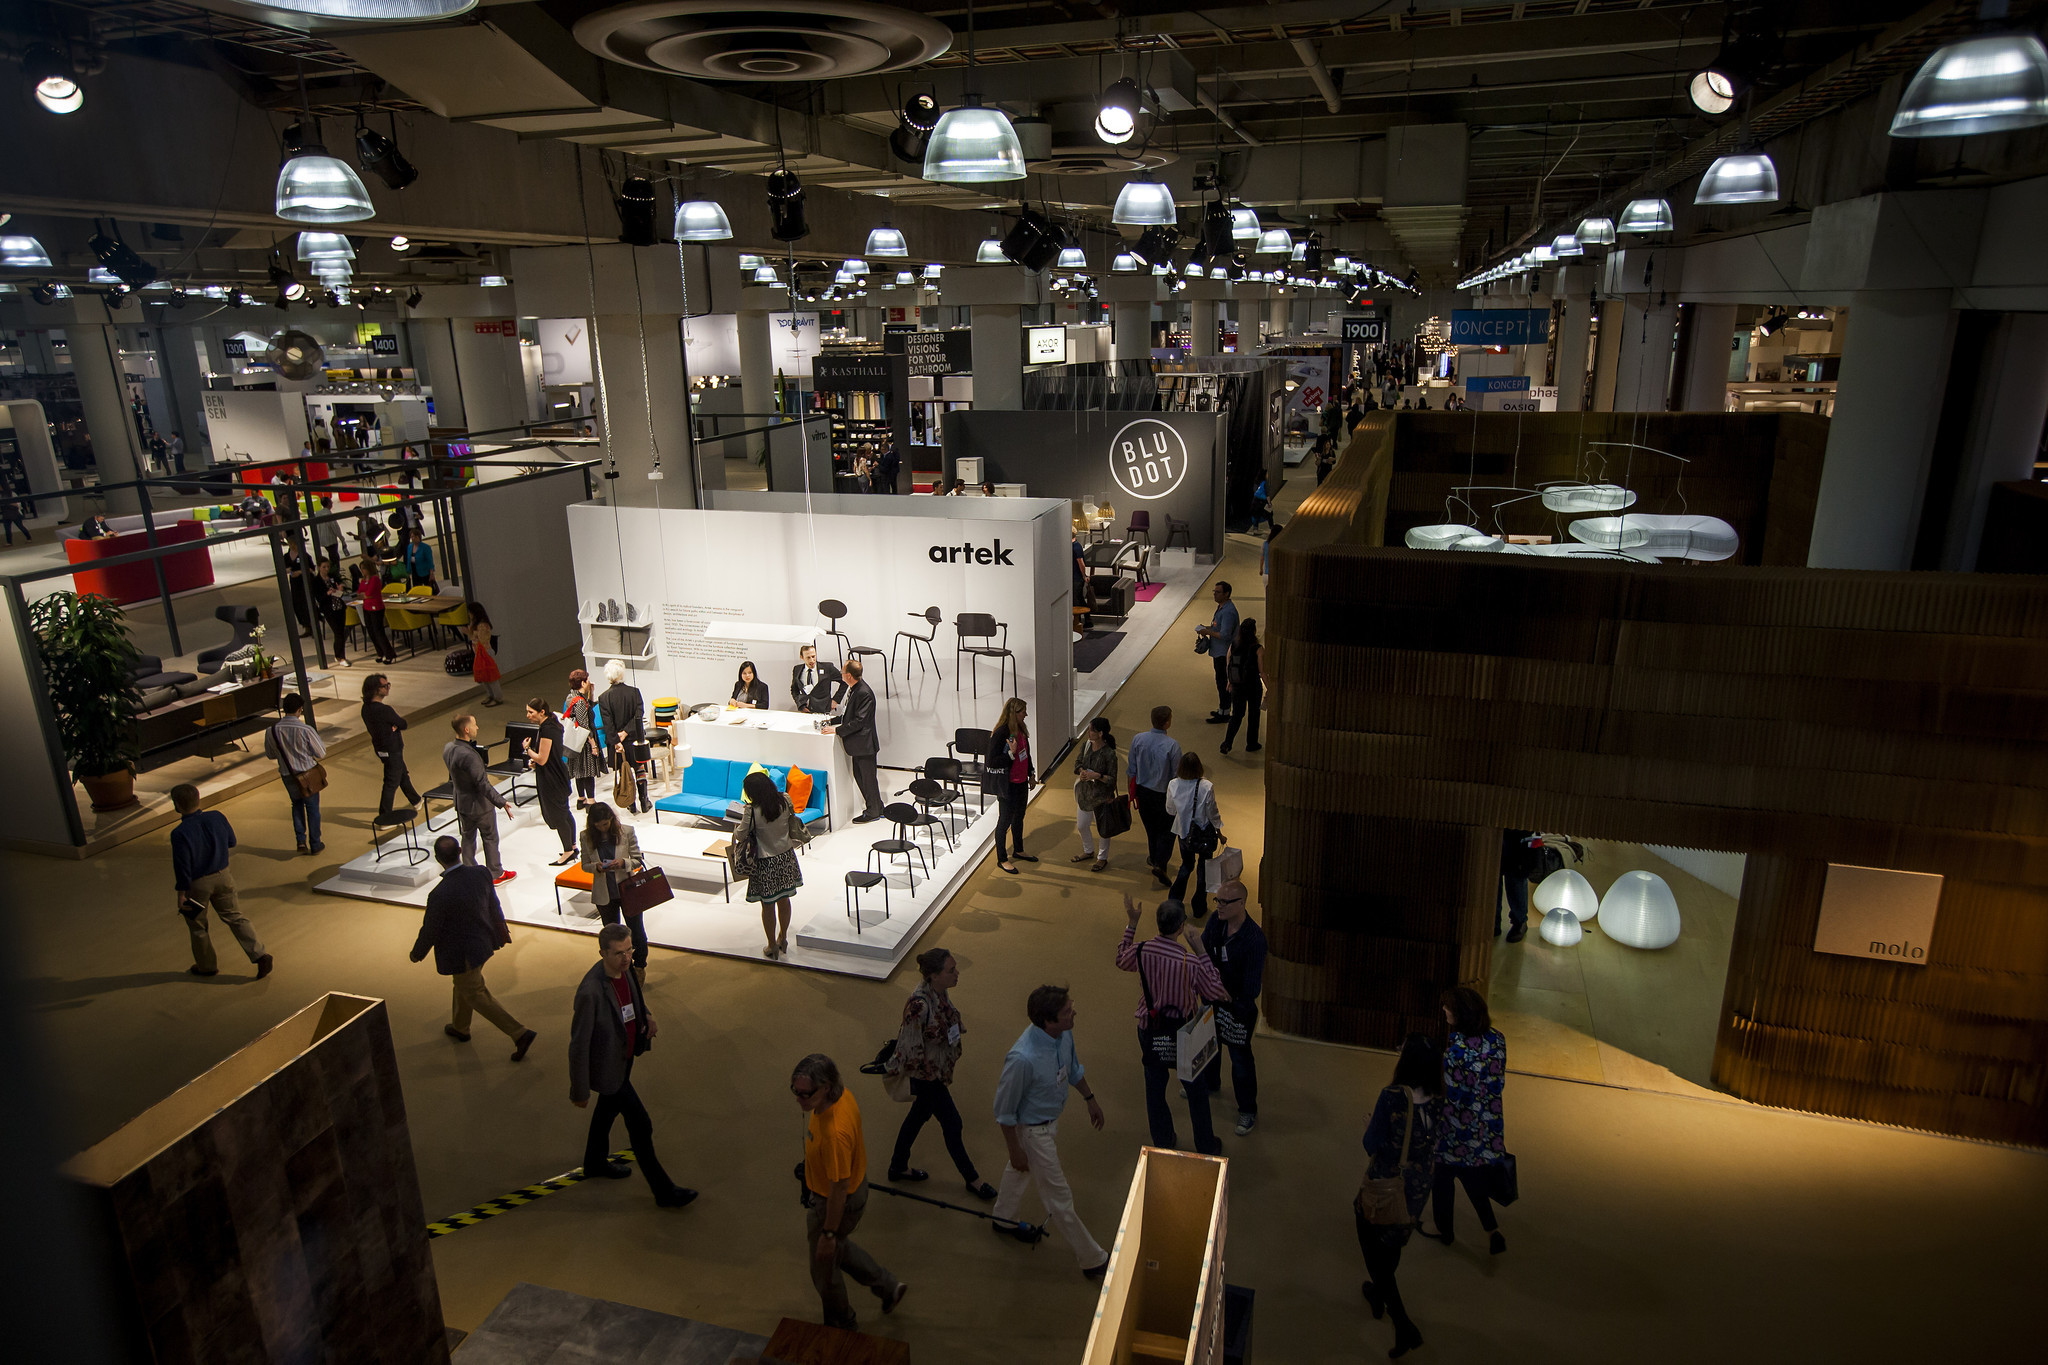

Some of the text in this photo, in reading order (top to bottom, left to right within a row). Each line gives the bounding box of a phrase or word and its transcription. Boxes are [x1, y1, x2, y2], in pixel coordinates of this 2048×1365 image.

[787, 317, 815, 327] DRAVIT
[1453, 320, 1525, 336] KONCEPT
[1345, 323, 1379, 338] 1900
[373, 339, 396, 351] 1400
[907, 333, 945, 345] DESIGNER
[1036, 338, 1059, 348] AXOR
[225, 342, 245, 355] 1300
[907, 344, 940, 354] VISIONS
[908, 352, 947, 365] FOR YOUR
[831, 366, 887, 376] KASTHALL
[908, 363, 952, 375] BATHROOM
[1488, 379, 1526, 390] KONCEPT
[205, 395, 224, 407] BEN
[208, 408, 227, 419] SEN
[1121, 431, 1168, 463] BLU
[1128, 456, 1172, 488] DOT
[929, 538, 1014, 566] artek
[1869, 941, 1924, 958] molo
